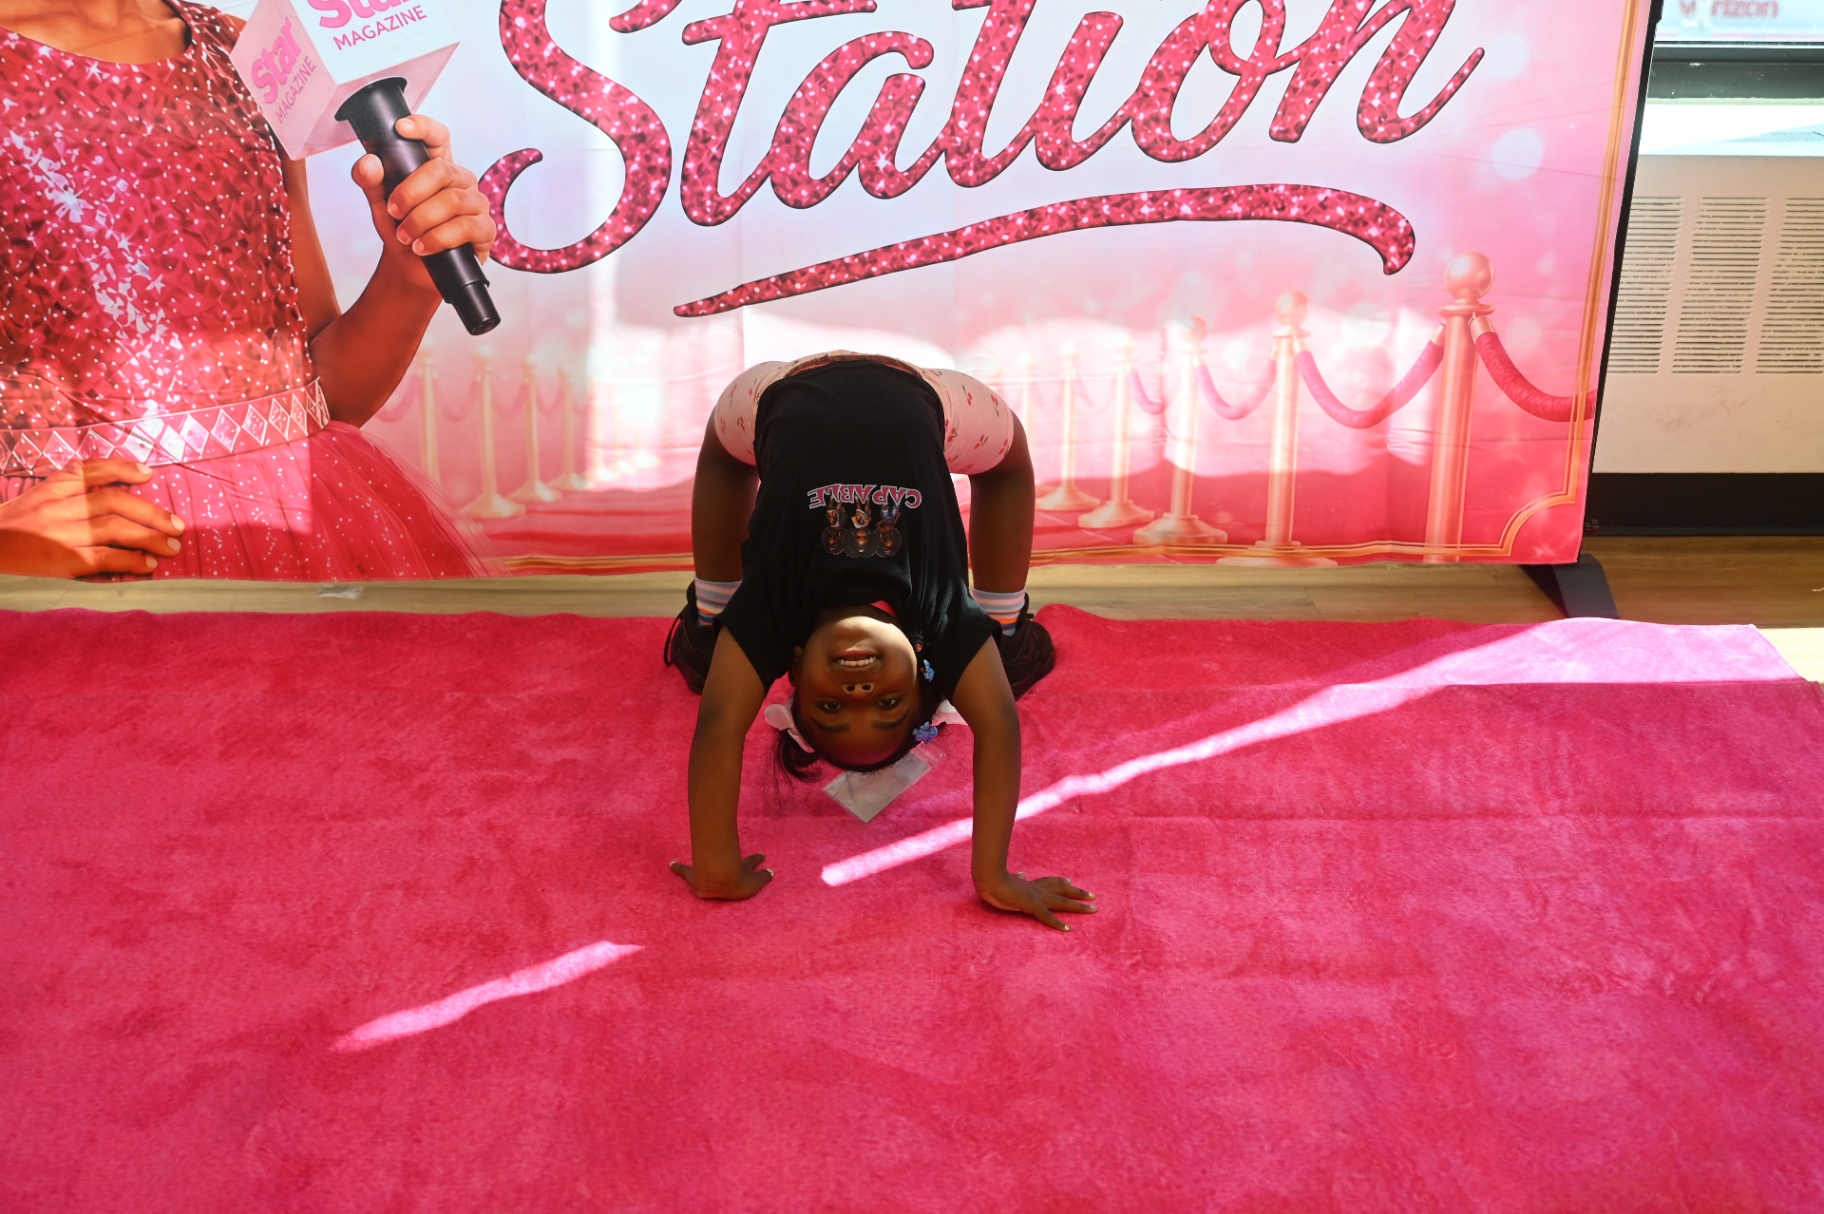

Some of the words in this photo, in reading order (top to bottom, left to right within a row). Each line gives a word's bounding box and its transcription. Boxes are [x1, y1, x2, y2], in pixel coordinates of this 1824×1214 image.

[251, 17, 302, 104] Star
[332, 5, 427, 51] MAGAZINE
[275, 55, 316, 124] MAGAZINE
[478, 0, 1486, 274] Station
[807, 483, 923, 509] CAPABLE
